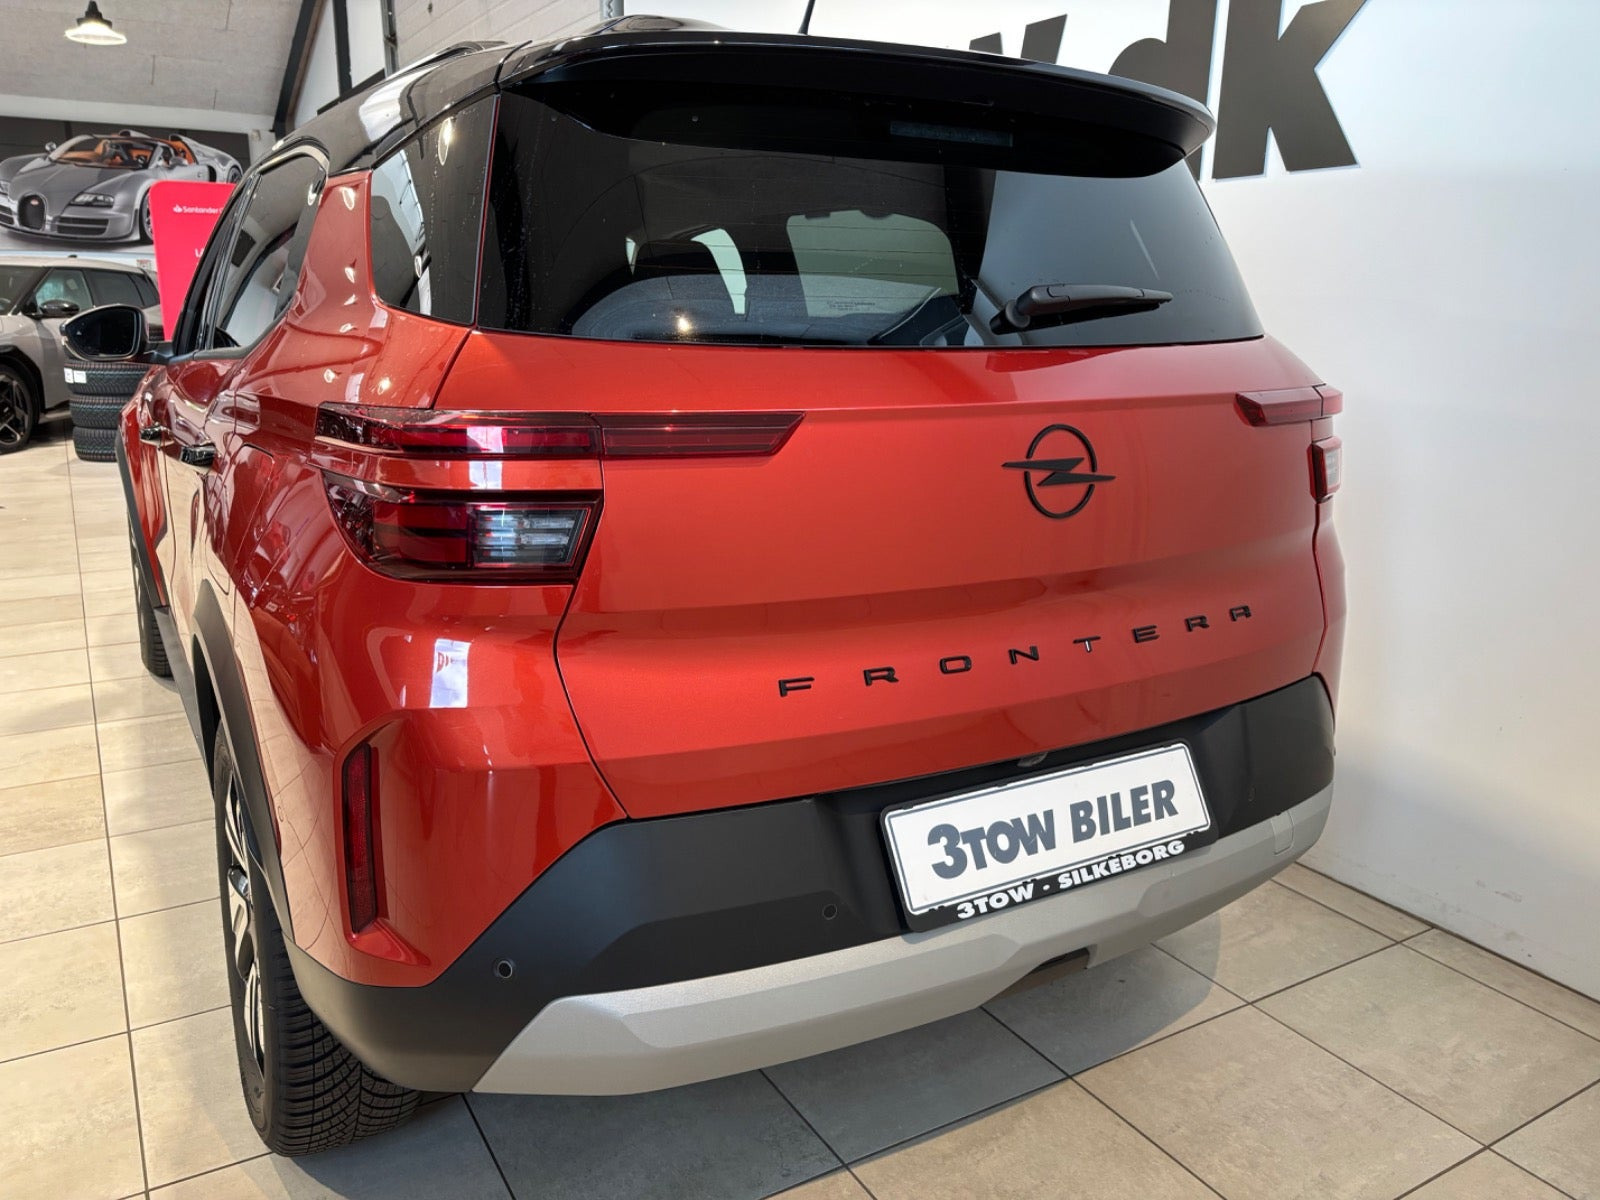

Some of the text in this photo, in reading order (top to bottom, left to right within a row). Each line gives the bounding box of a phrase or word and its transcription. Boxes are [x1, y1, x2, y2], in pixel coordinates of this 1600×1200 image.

[182, 205, 218, 214] Santander
[777, 604, 1253, 698] FRONTERA
[927, 779, 1179, 880] 3TOW BILER
[956, 840, 1185, 920] 3TOW SILKEBORG
